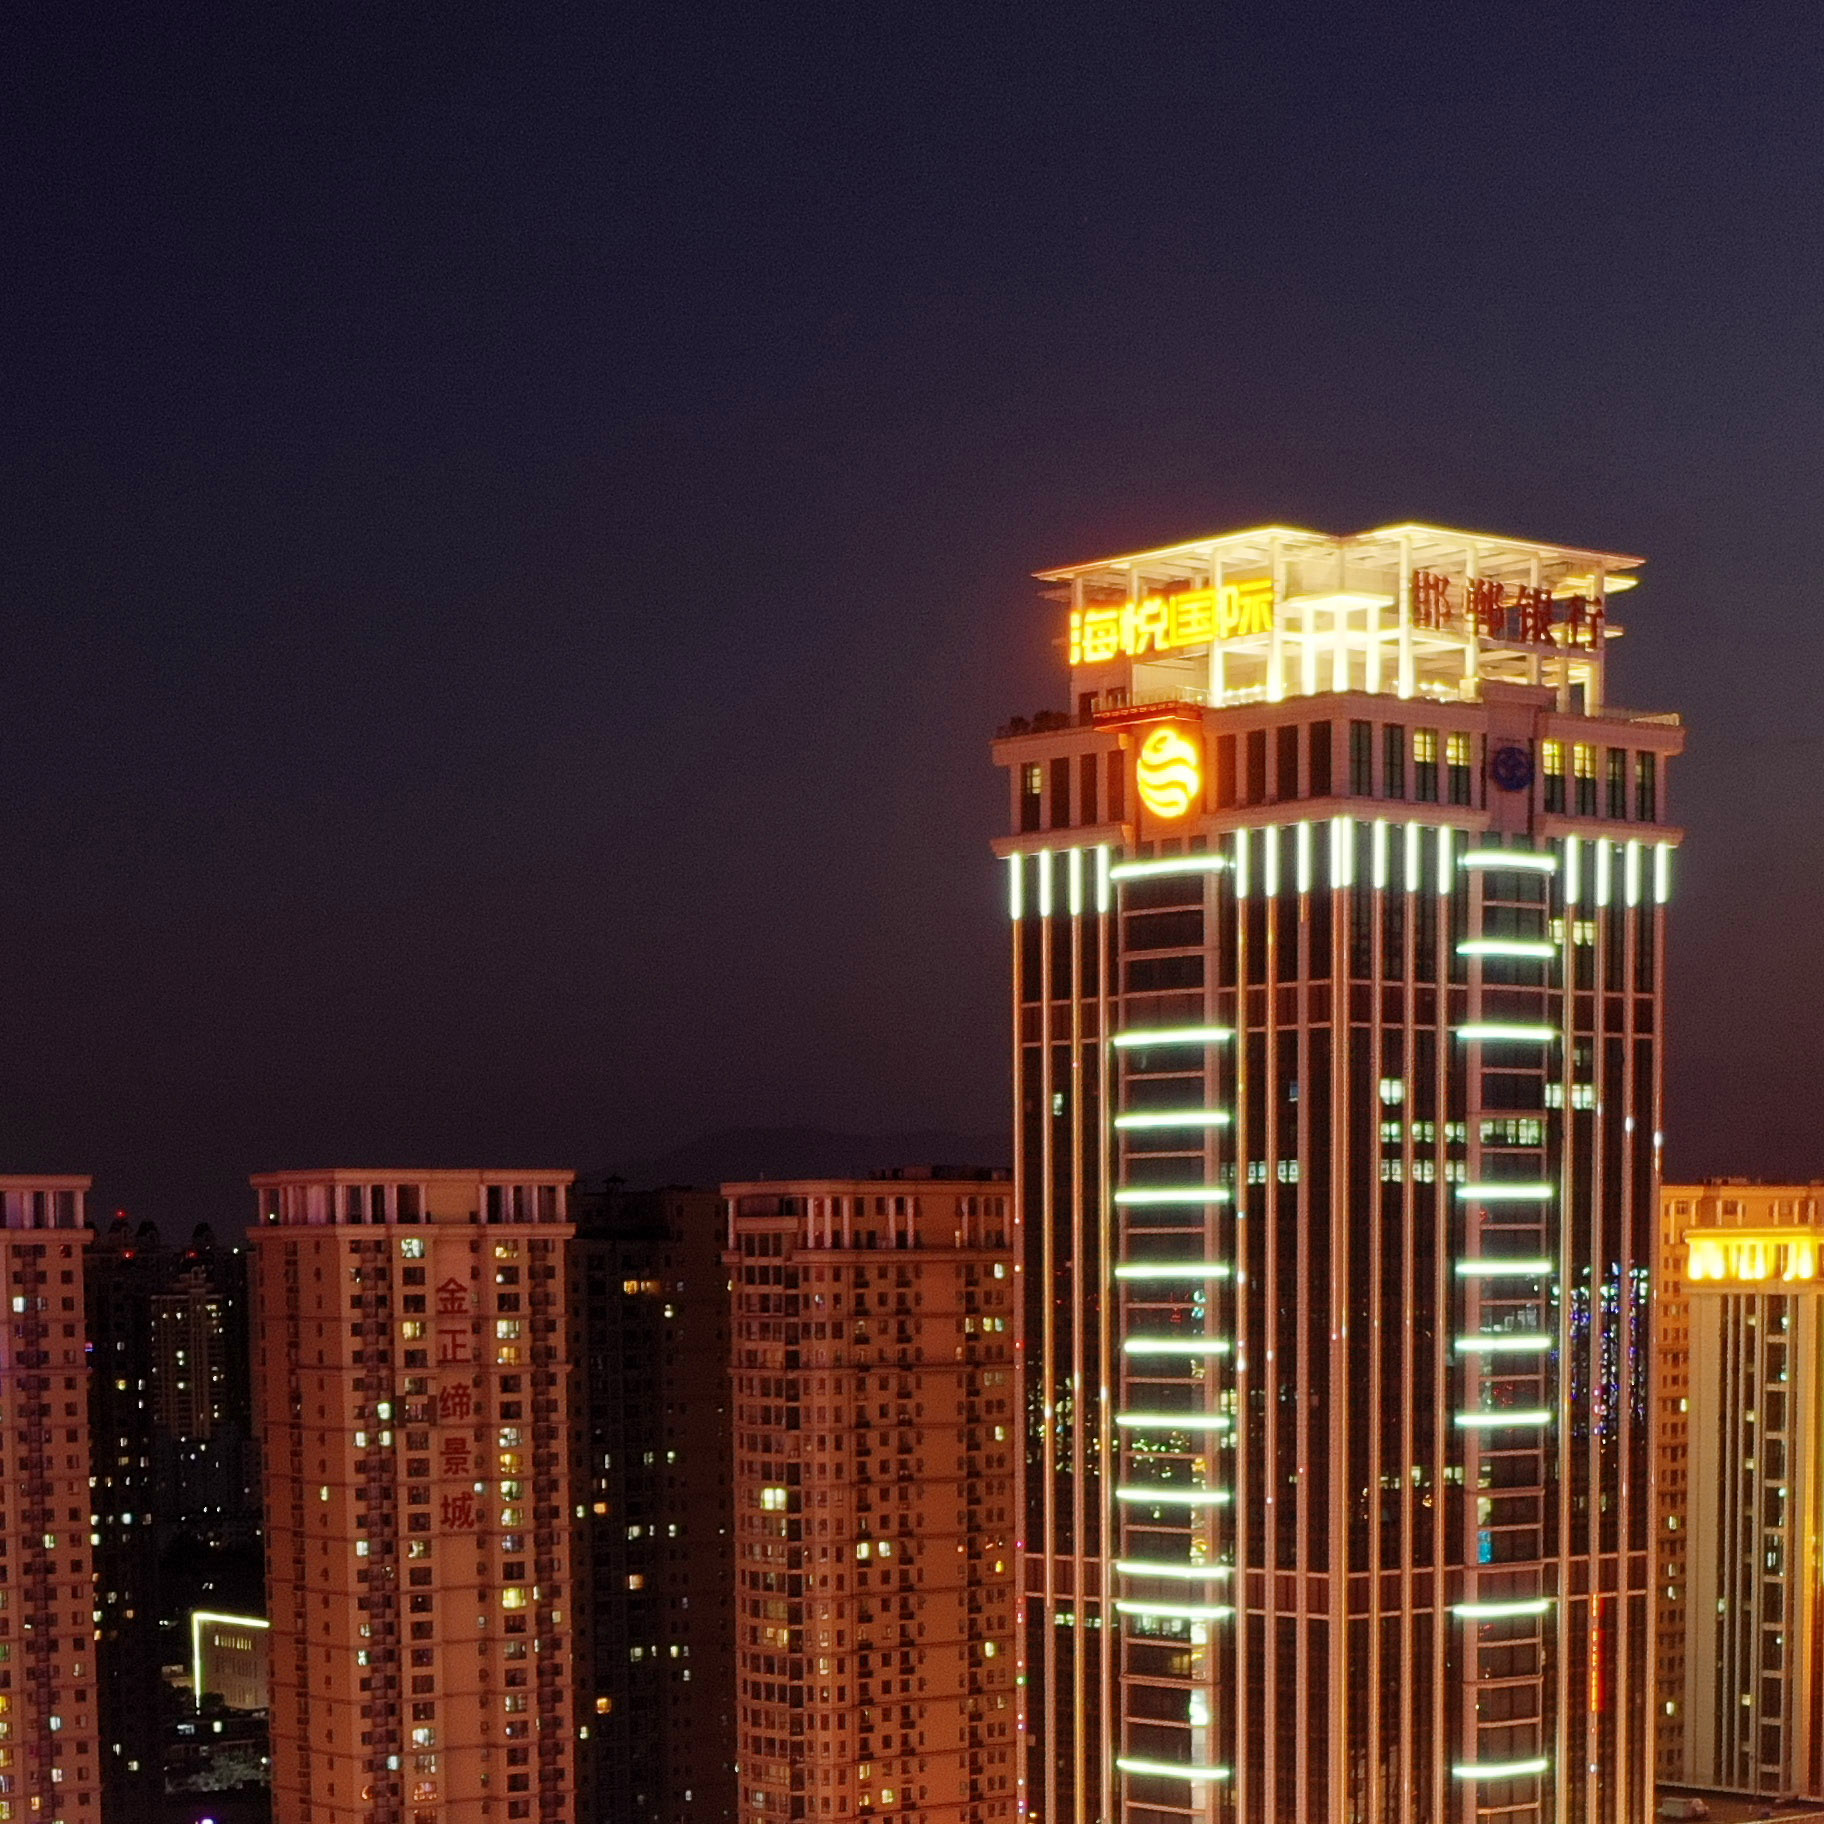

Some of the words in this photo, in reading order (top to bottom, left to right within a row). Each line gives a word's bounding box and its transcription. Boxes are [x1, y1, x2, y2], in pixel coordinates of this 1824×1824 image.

[1069, 579, 1275, 664] 海悦国际
[1412, 568, 1604, 652] 邯郸银行
[435, 1277, 475, 1530] 金正缔景城
